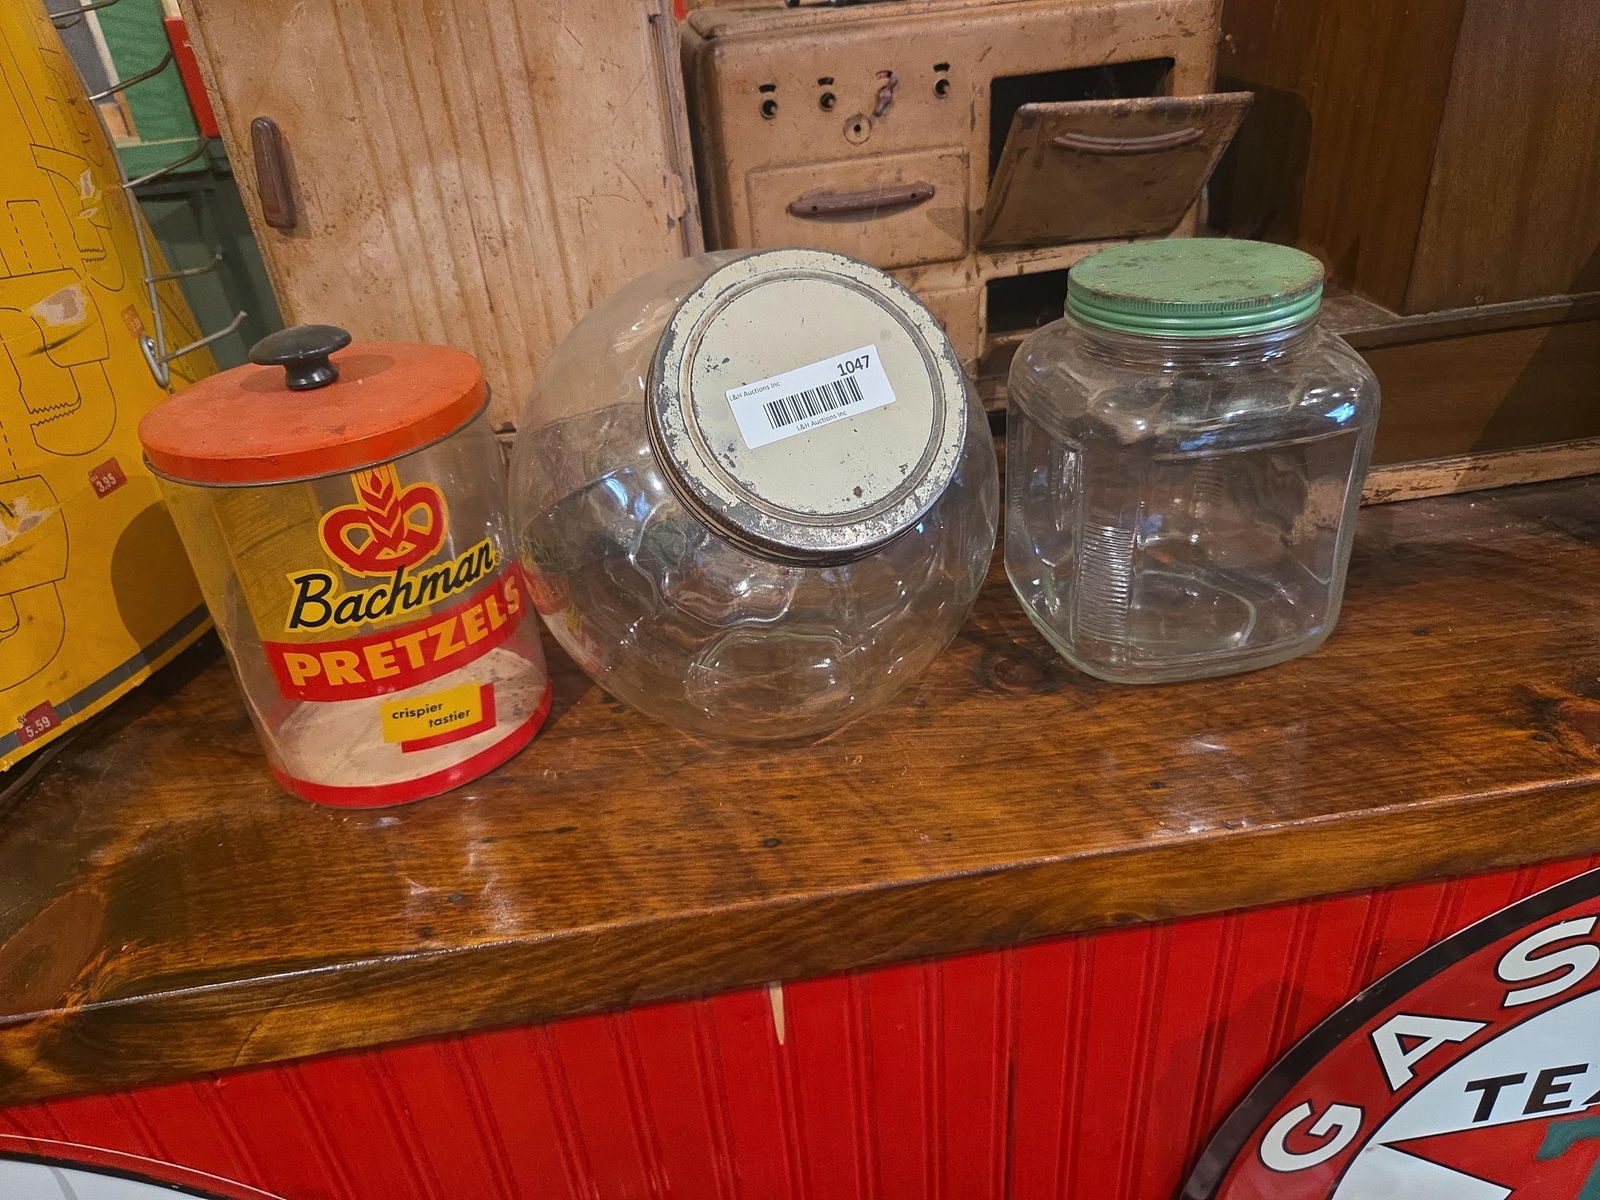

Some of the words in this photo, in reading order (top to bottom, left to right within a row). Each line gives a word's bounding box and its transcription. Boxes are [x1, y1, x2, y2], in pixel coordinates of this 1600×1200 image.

[837, 355, 870, 377] 1047
[729, 392, 742, 402] L&H
[743, 384, 770, 397] Auctions
[770, 380, 781, 390] Inc
[796, 421, 811, 431] L&H
[811, 413, 837, 427] Auctions
[836, 410, 848, 419] Inc
[95, 471, 118, 493] 3.95
[286, 538, 495, 631] Bachman
[283, 575, 520, 687] PRETZELS
[391, 702, 444, 720] crispier
[428, 708, 472, 729] tastier
[25, 715, 51, 738] 5.59
[1259, 914, 1600, 1173] GAS
